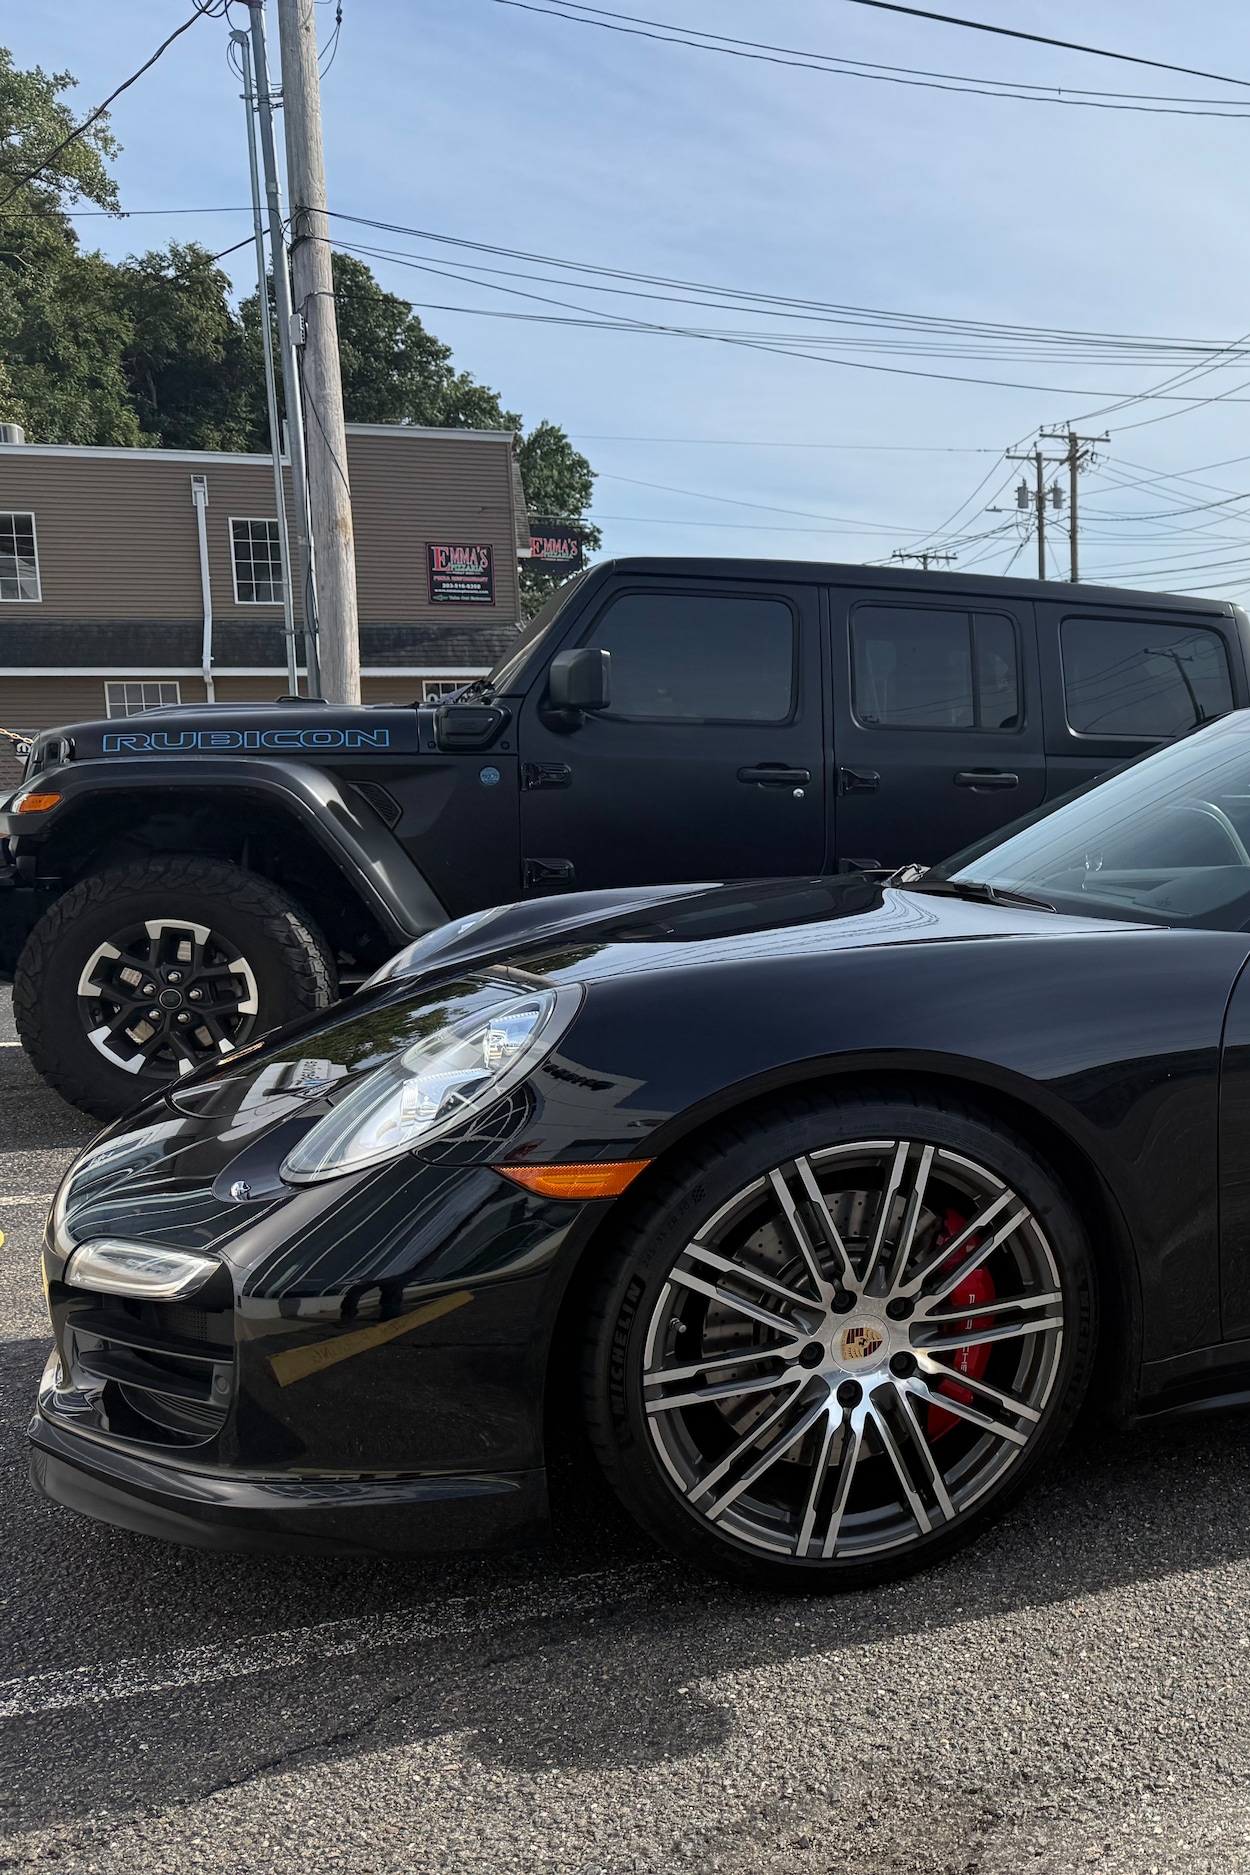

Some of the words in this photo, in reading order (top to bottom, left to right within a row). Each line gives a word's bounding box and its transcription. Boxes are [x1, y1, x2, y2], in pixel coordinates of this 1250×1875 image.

[431, 546, 489, 572] EMMA'S
[530, 537, 579, 558] EMMA'S
[103, 729, 390, 752] RUBICON
[611, 1282, 643, 1415] MICHELIN
